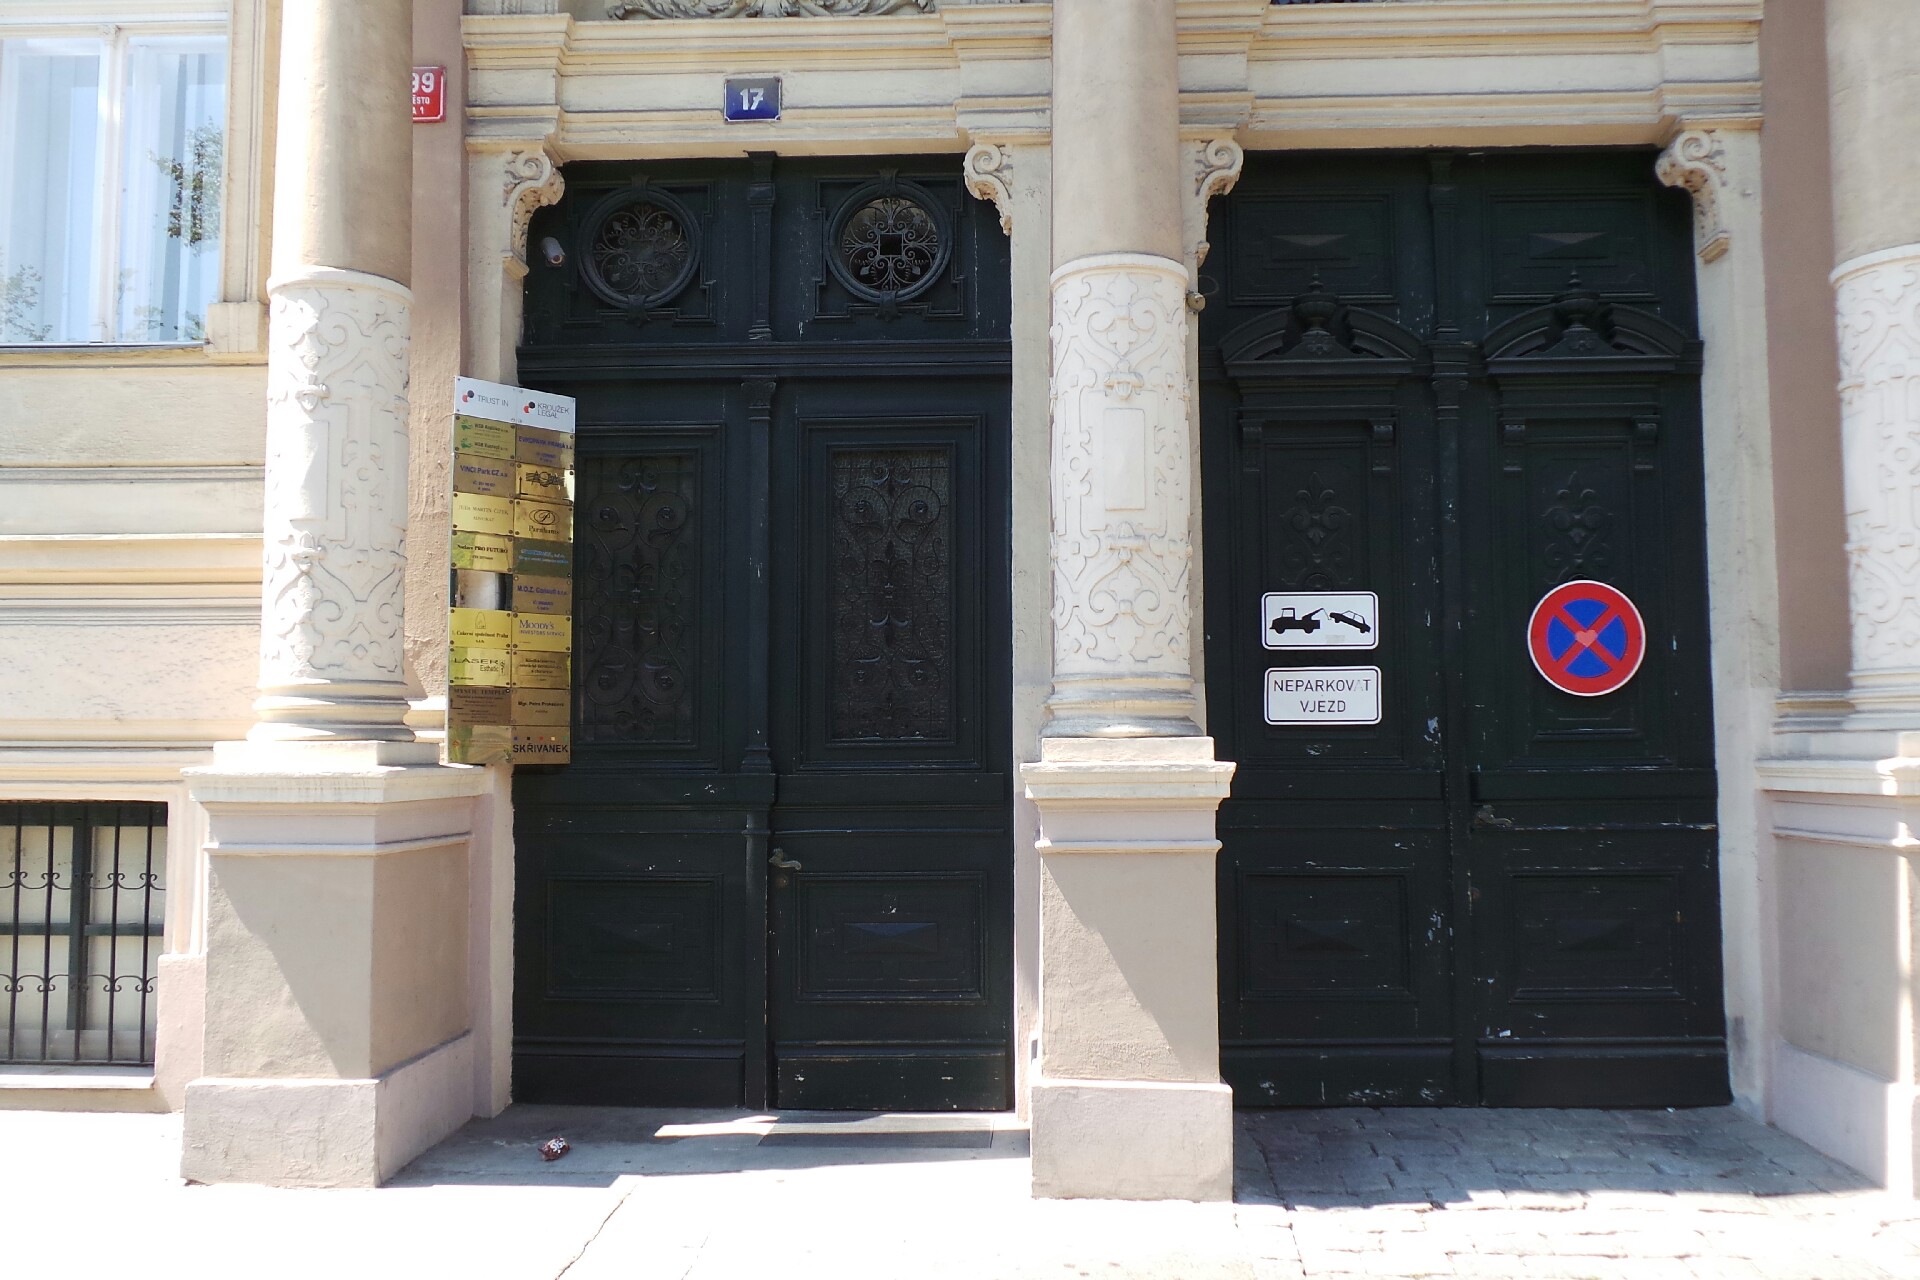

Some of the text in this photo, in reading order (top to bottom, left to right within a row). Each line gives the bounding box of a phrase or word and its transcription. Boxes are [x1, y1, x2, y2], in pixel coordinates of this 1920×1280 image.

[740, 88, 764, 110] 17
[478, 394, 509, 407] TRUST IN
[537, 402, 570, 415] KROUŽEK
[537, 409, 558, 418] LEGAL
[477, 467, 491, 475] Park
[491, 469, 500, 477] CZ
[486, 546, 509, 554] FUTURO
[454, 657, 499, 665] LASER
[1300, 700, 1346, 712] VJEZD
